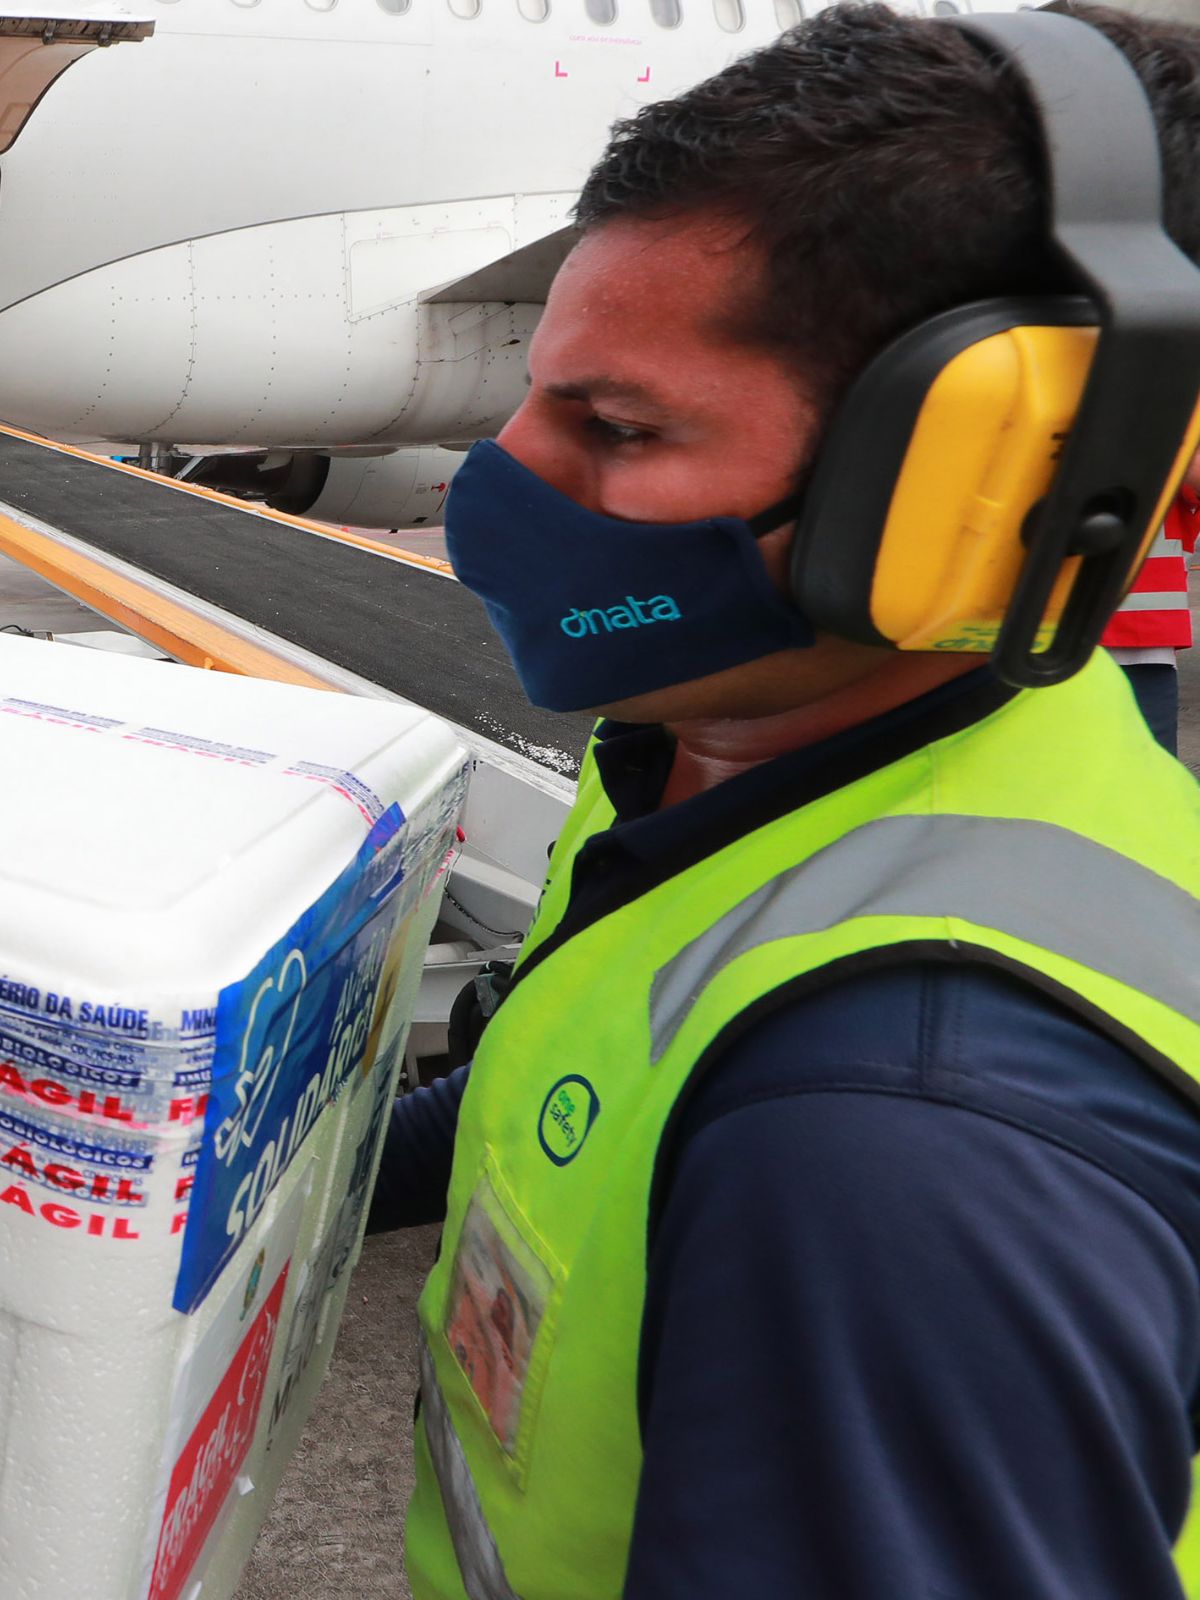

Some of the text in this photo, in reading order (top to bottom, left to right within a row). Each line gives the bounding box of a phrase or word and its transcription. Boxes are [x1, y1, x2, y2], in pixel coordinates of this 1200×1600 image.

[560, 595, 683, 638] dnata
[45, 991, 73, 1020] DA
[79, 1002, 149, 1036] SAÚDE
